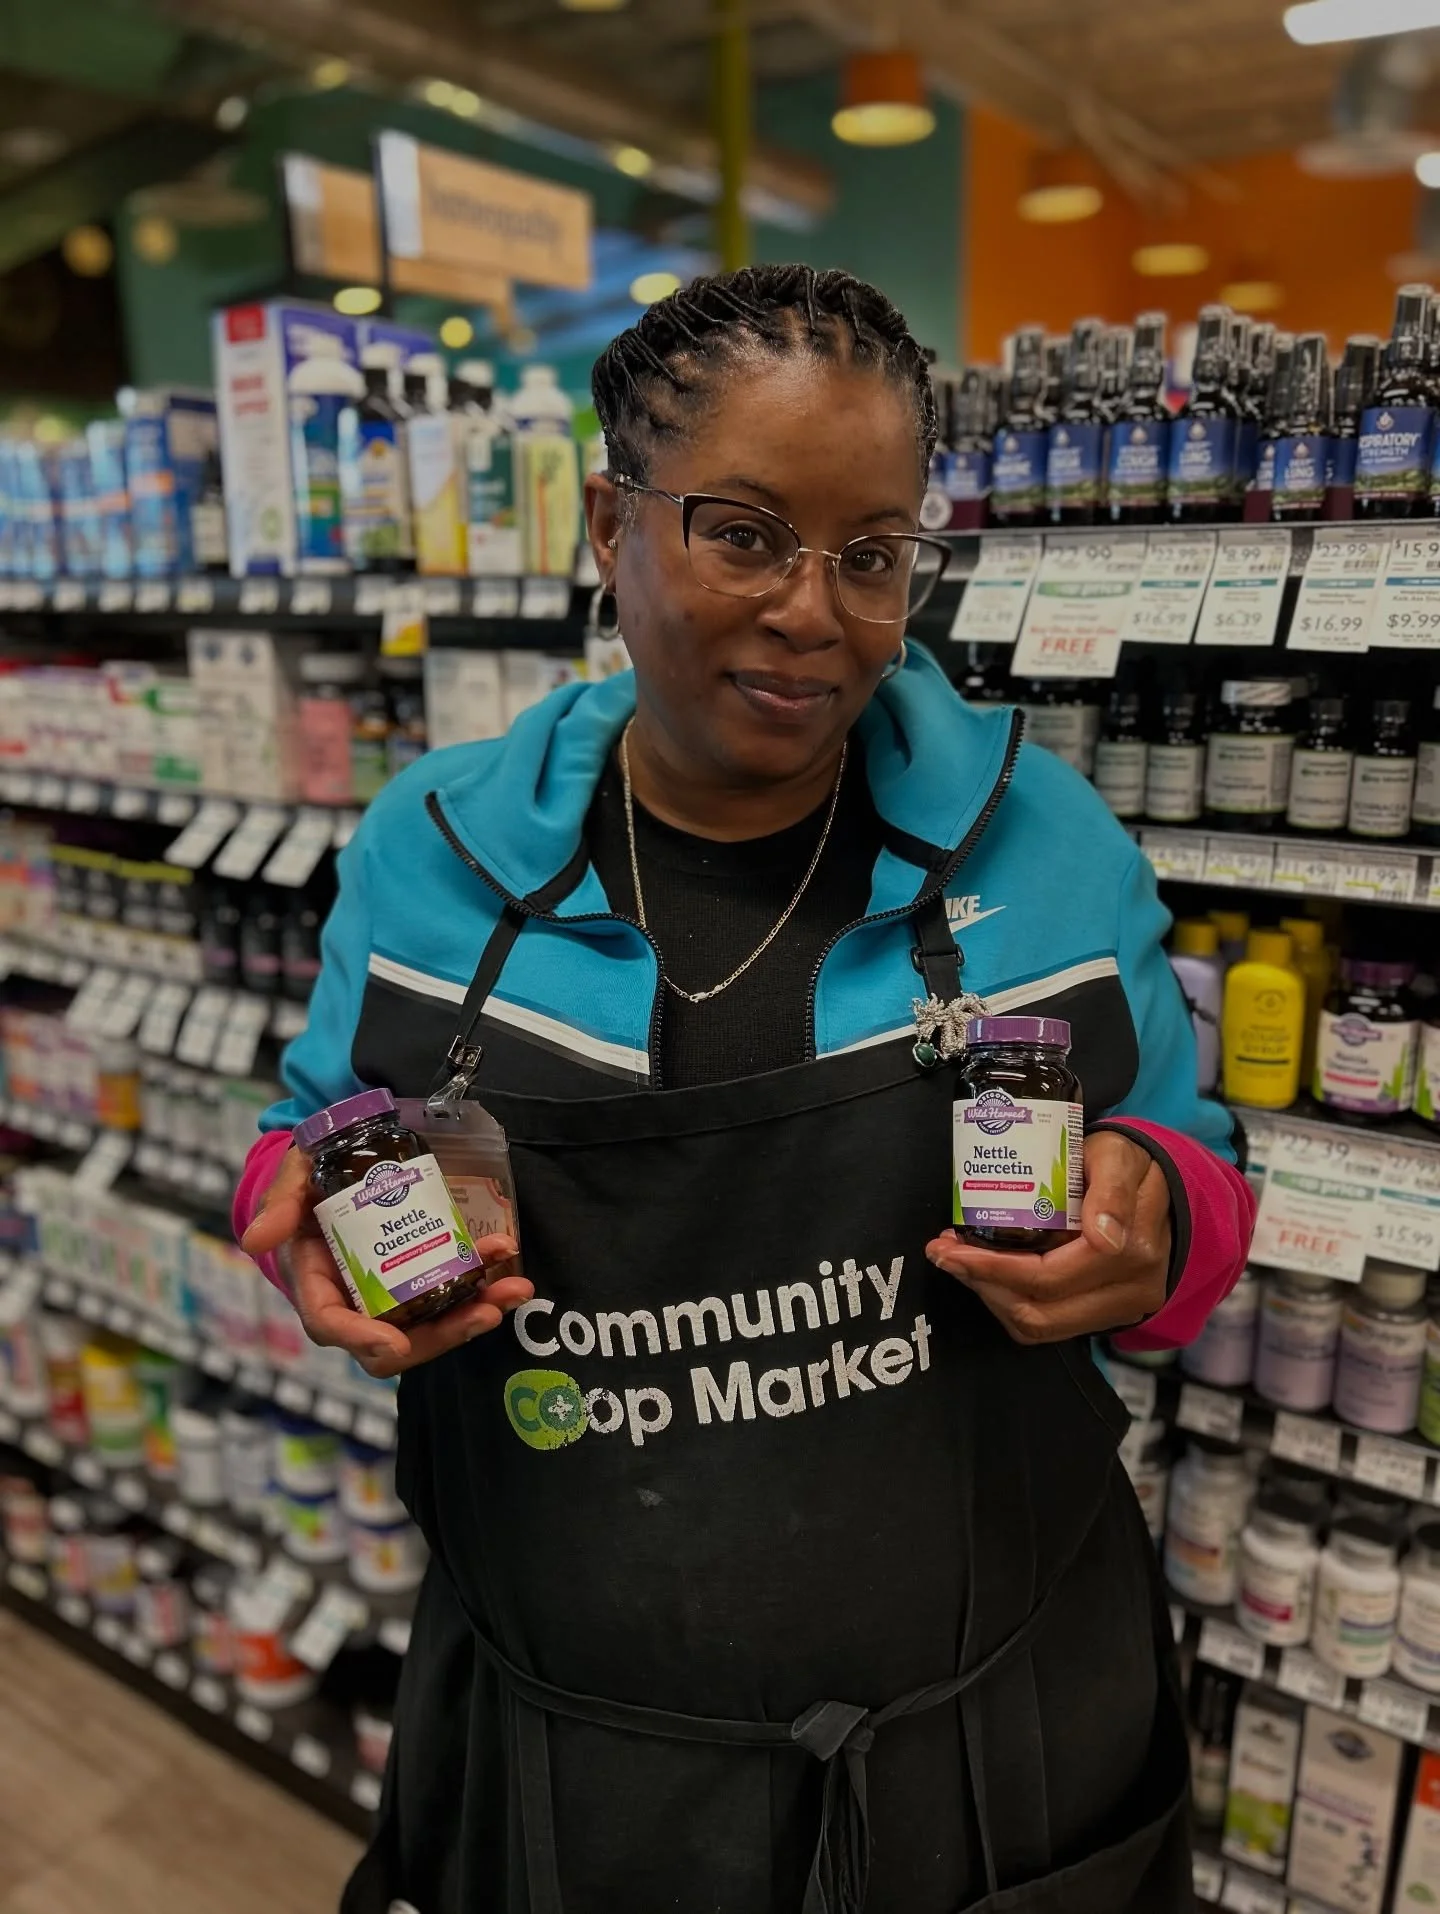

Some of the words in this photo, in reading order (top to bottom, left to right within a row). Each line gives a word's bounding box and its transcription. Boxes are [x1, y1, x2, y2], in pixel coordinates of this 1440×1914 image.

[1316, 542, 1368, 558] $22.99
[1300, 615, 1363, 632] $16.99
[1386, 613, 1440, 629] $9.99
[1041, 637, 1098, 655] FREE
[978, 1092, 1011, 1106] OREGON'S
[966, 1108, 988, 1119] Wild
[987, 1107, 1027, 1120] Harvest
[973, 1146, 1018, 1159] Nettle
[366, 1164, 401, 1184] OREGON'S
[963, 1160, 1034, 1176] Quercetin
[357, 1184, 384, 1203] Wild
[382, 1170, 417, 1191] Harvest
[380, 1208, 428, 1237] Nettle
[975, 1210, 989, 1220] 60
[373, 1217, 446, 1257] Quercetin
[1279, 1230, 1340, 1255] FREE
[410, 1277, 426, 1291] 60
[514, 1256, 905, 1357] Community
[690, 1314, 932, 1425] Market
